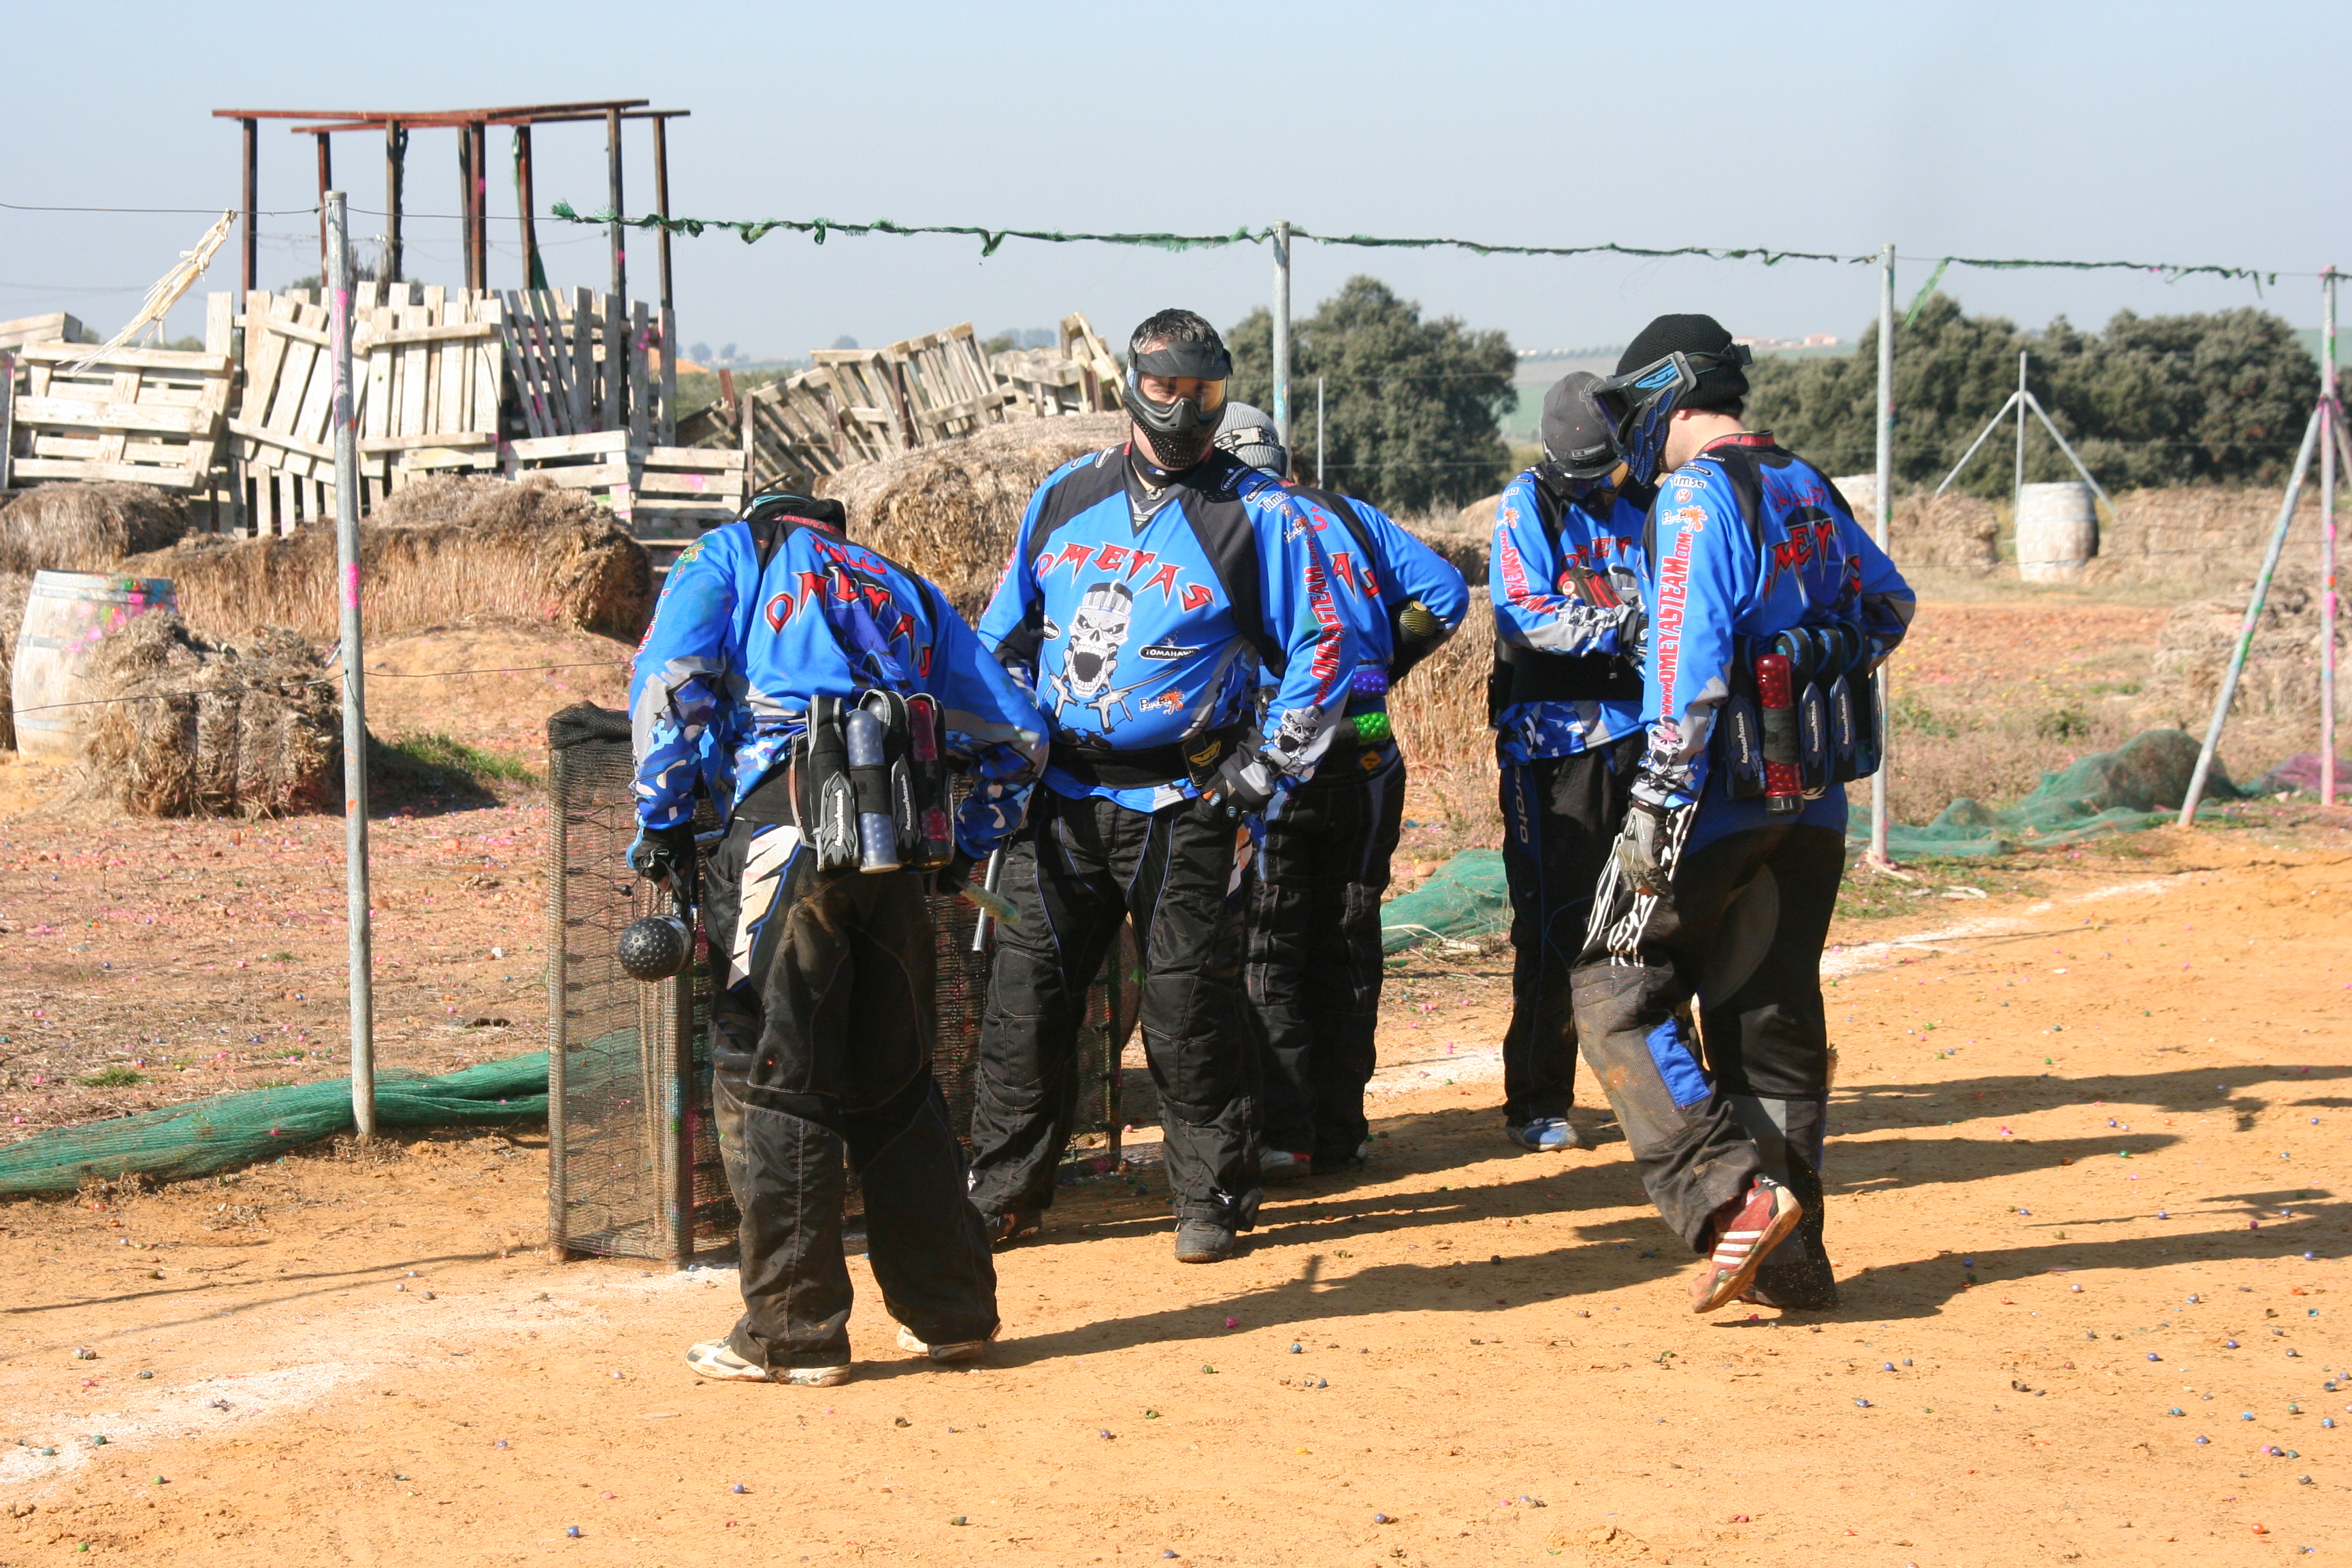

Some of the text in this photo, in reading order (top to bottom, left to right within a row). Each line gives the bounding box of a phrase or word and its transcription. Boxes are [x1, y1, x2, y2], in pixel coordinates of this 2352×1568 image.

[1037, 540, 1216, 615] OMEYAS
[1735, 711, 1749, 764] tomahawk
[834, 788, 844, 847] tomahawk
